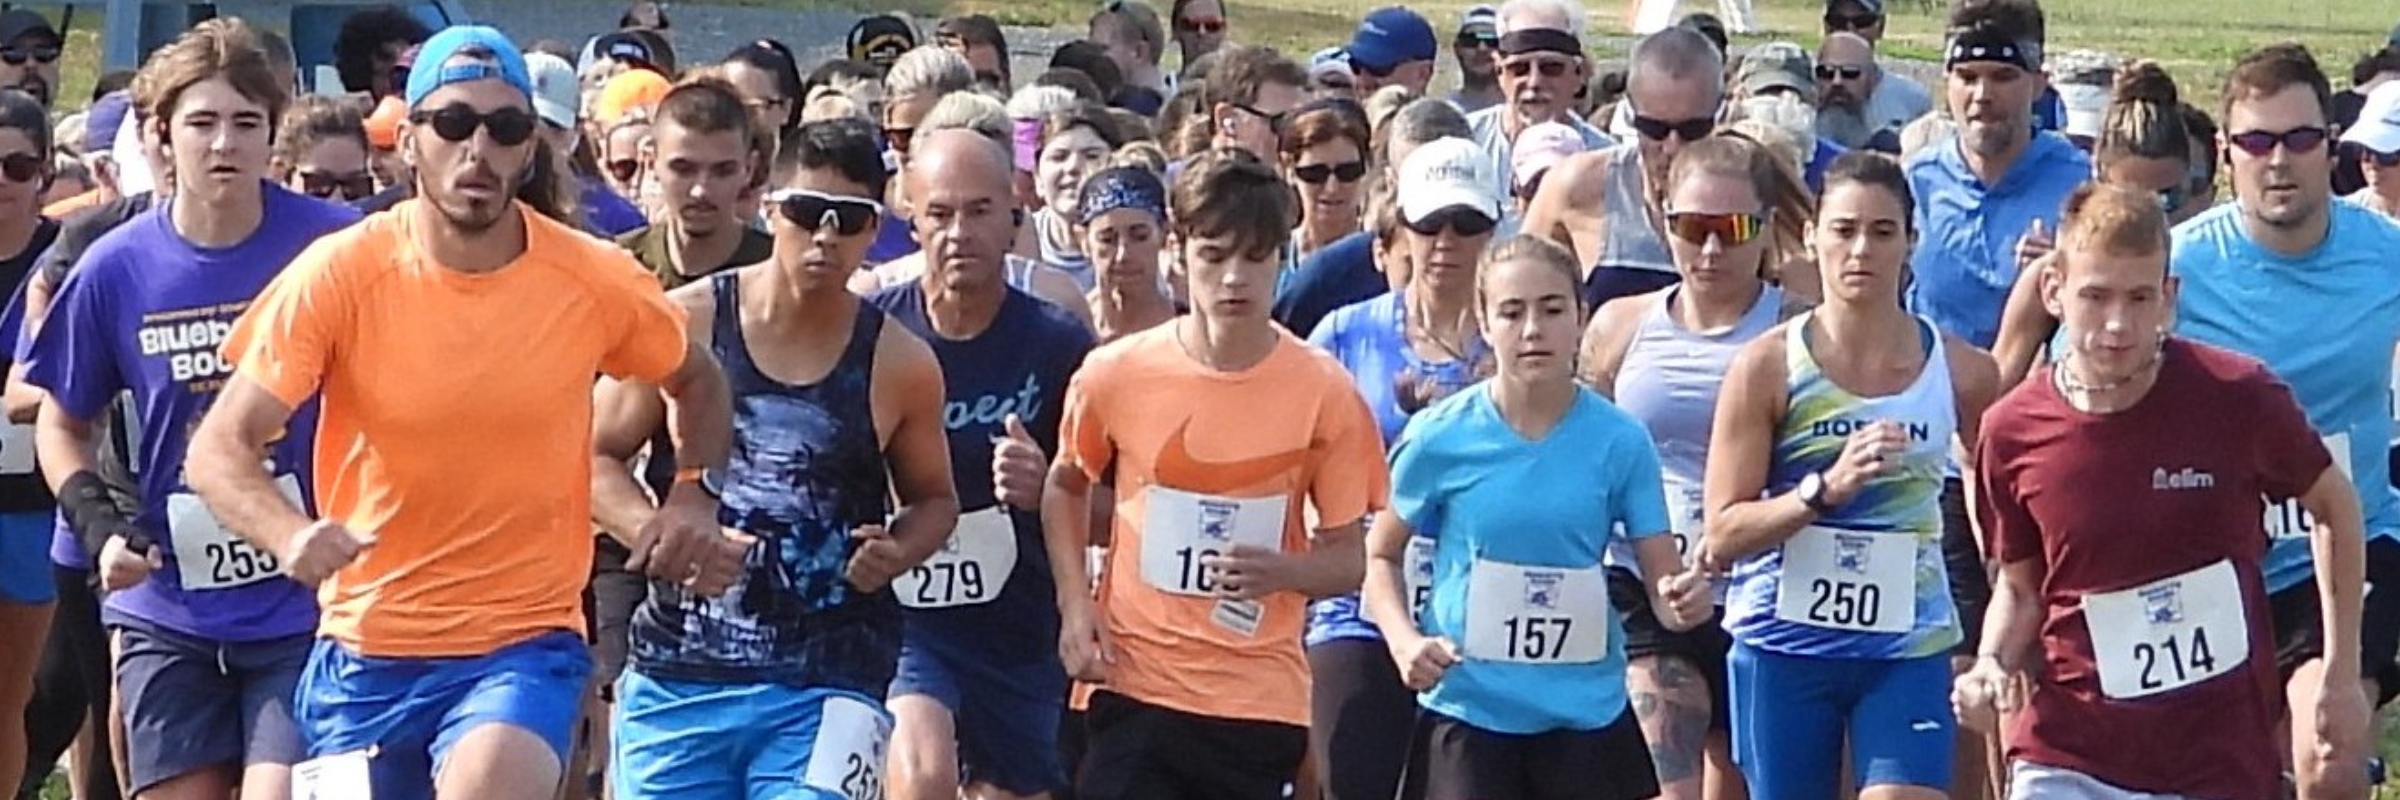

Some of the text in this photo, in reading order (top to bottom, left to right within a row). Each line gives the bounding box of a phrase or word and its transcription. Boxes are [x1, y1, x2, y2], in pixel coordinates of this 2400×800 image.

[1812, 419, 1928, 442] BON
[911, 560, 985, 604] 279
[1807, 577, 1880, 627] 250
[1503, 615, 1572, 659] 157
[2133, 626, 2215, 690] 214
